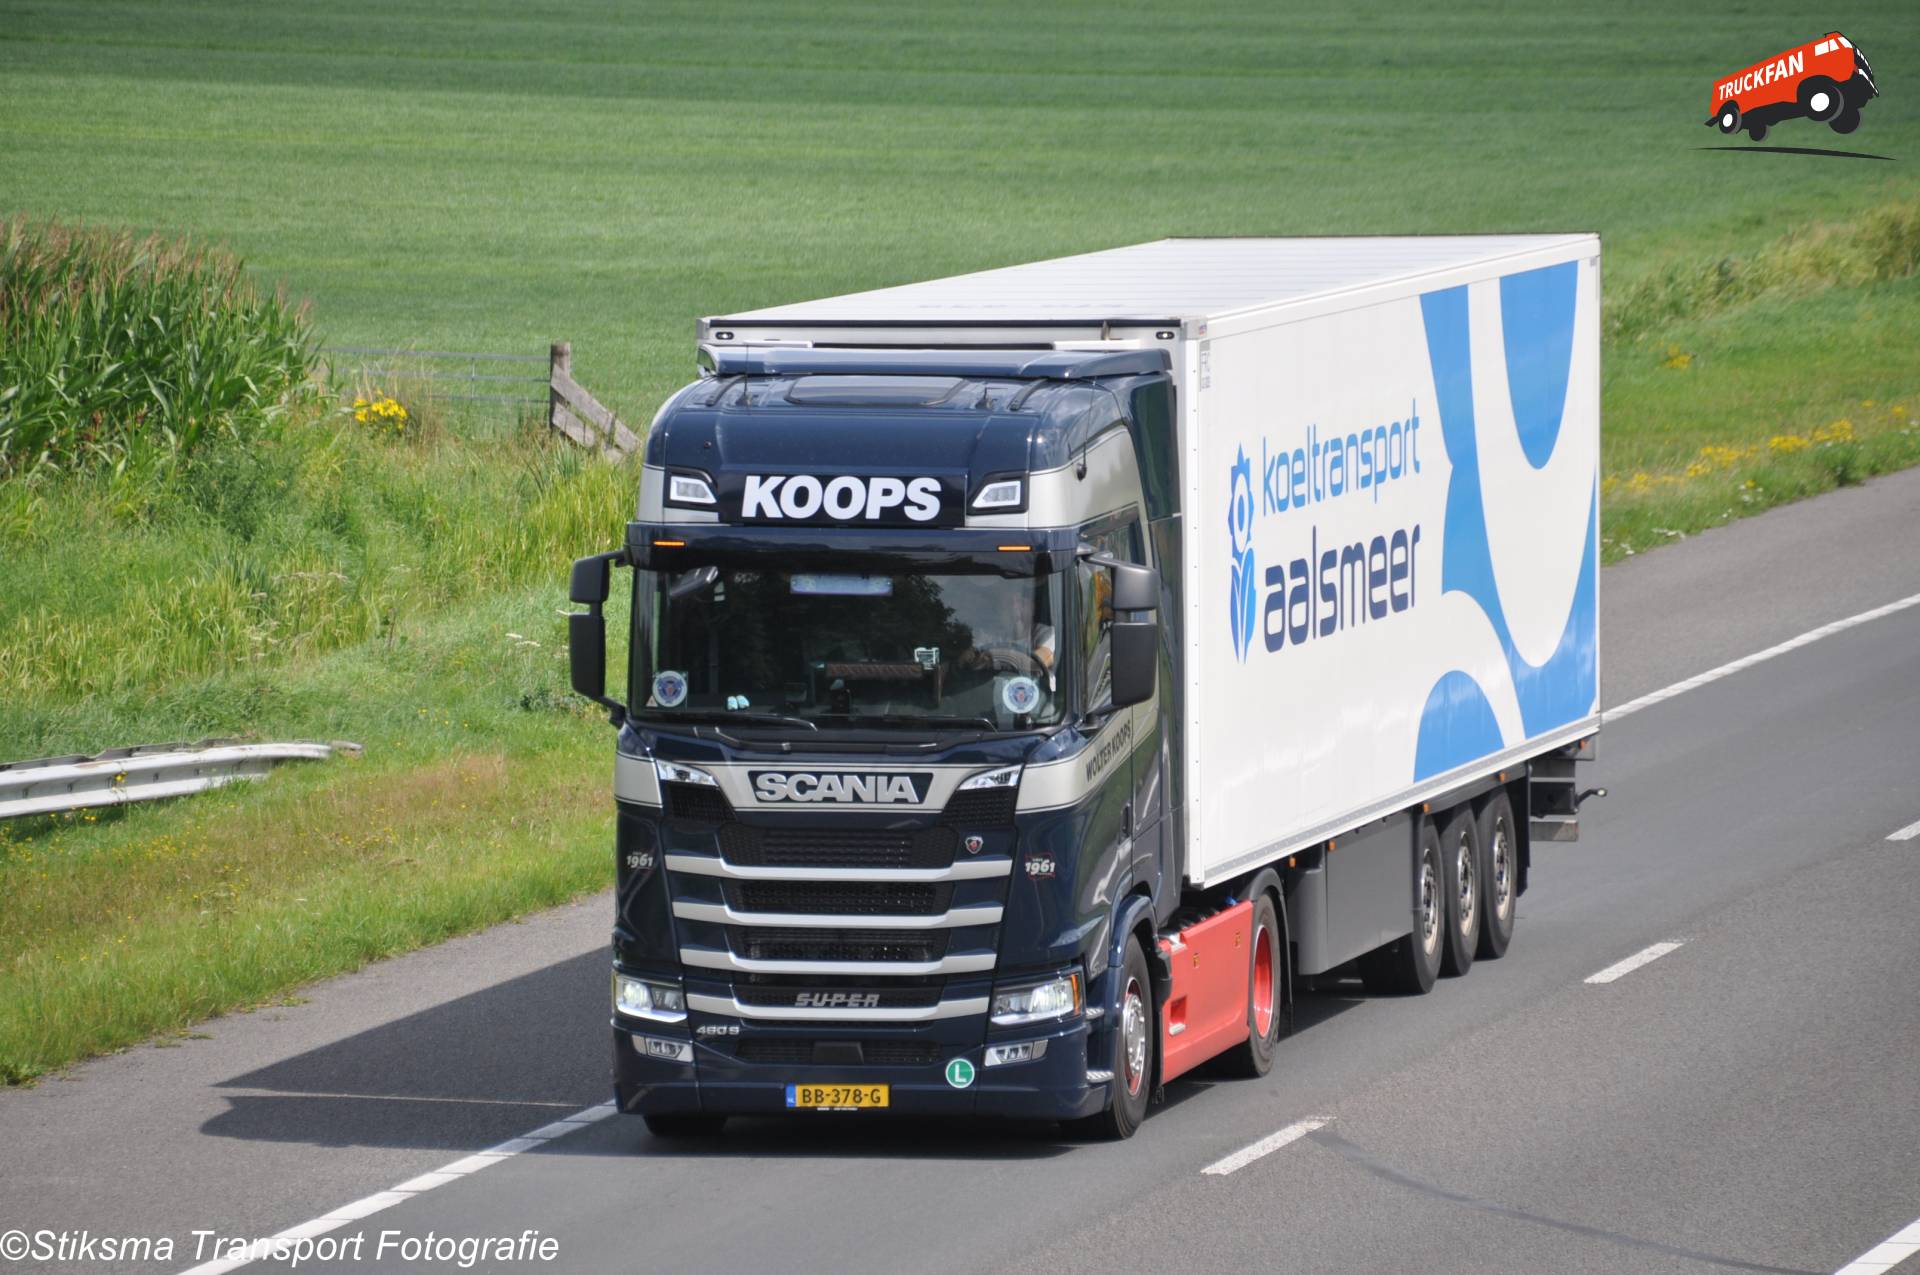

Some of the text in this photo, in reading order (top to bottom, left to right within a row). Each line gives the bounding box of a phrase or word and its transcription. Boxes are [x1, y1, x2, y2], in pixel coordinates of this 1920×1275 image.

[1263, 398, 1420, 517] koeltransport
[741, 475, 942, 522] KOOPS
[1264, 524, 1420, 653] aalsmeer
[1086, 719, 1131, 782] WOLTER KOOPS
[756, 773, 919, 803] SCANIA
[626, 853, 653, 868] 1961
[1025, 859, 1056, 875] 1961
[794, 993, 880, 1008] SUPER
[955, 1064, 967, 1083] L
[802, 1088, 881, 1104] BB-378-G
